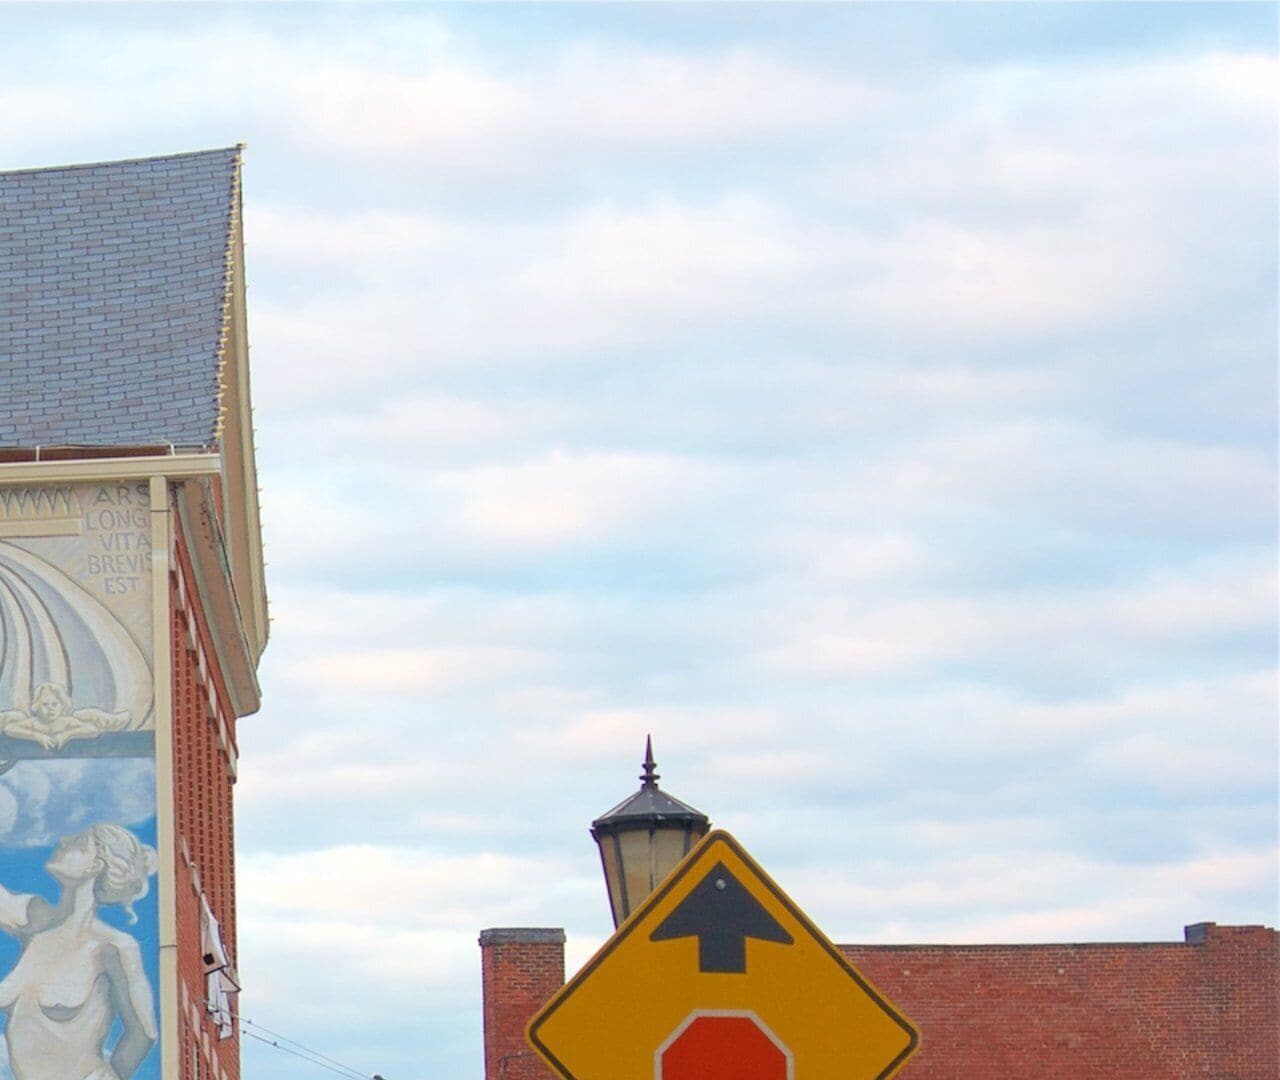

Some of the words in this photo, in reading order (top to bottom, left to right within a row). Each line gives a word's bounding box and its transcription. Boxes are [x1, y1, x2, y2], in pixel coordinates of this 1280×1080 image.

[92, 484, 151, 507] ARS
[84, 509, 152, 531] LONG
[99, 532, 152, 551] VITA
[103, 576, 140, 595] EST
